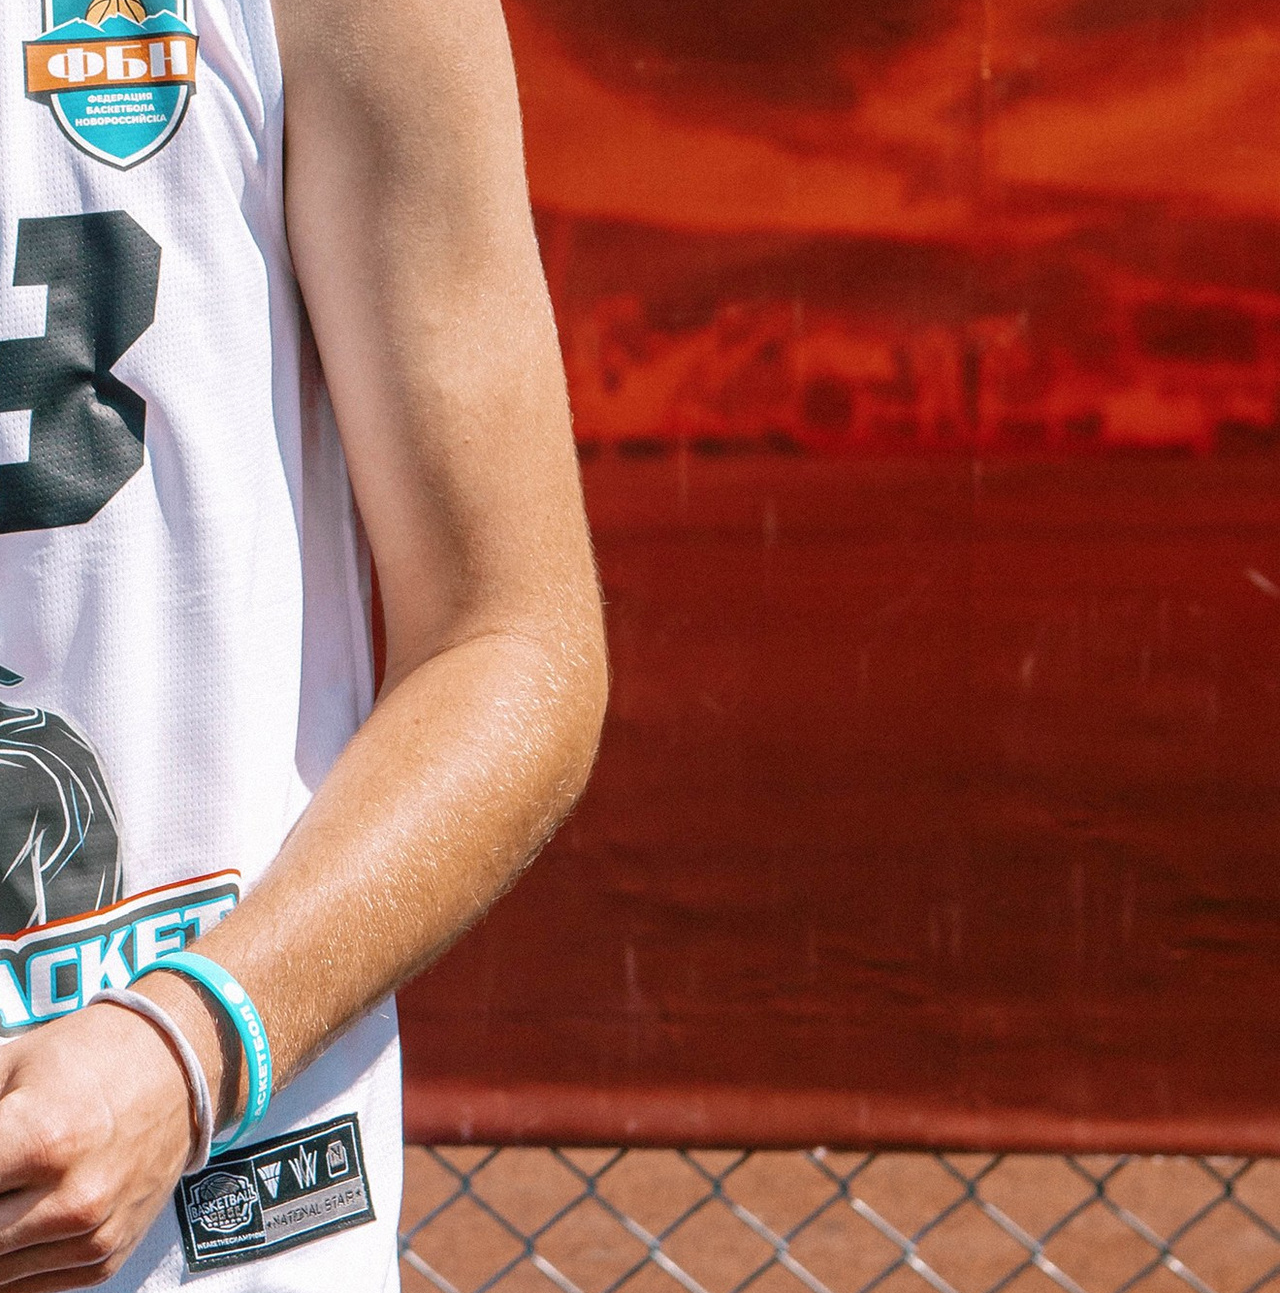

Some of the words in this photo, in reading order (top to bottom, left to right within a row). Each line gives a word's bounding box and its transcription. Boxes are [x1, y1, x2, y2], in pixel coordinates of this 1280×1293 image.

[47, 40, 188, 83] ФБН
[85, 103, 156, 115] БАСКЕТБОЛА
[86, 92, 153, 104] ФЕДЕРАЦИЯ
[75, 114, 167, 127] НОВОРОССИЙСКА
[240, 1005, 269, 1119] АСКЕТБОЛ
[191, 1187, 258, 1219] BASKETBALL
